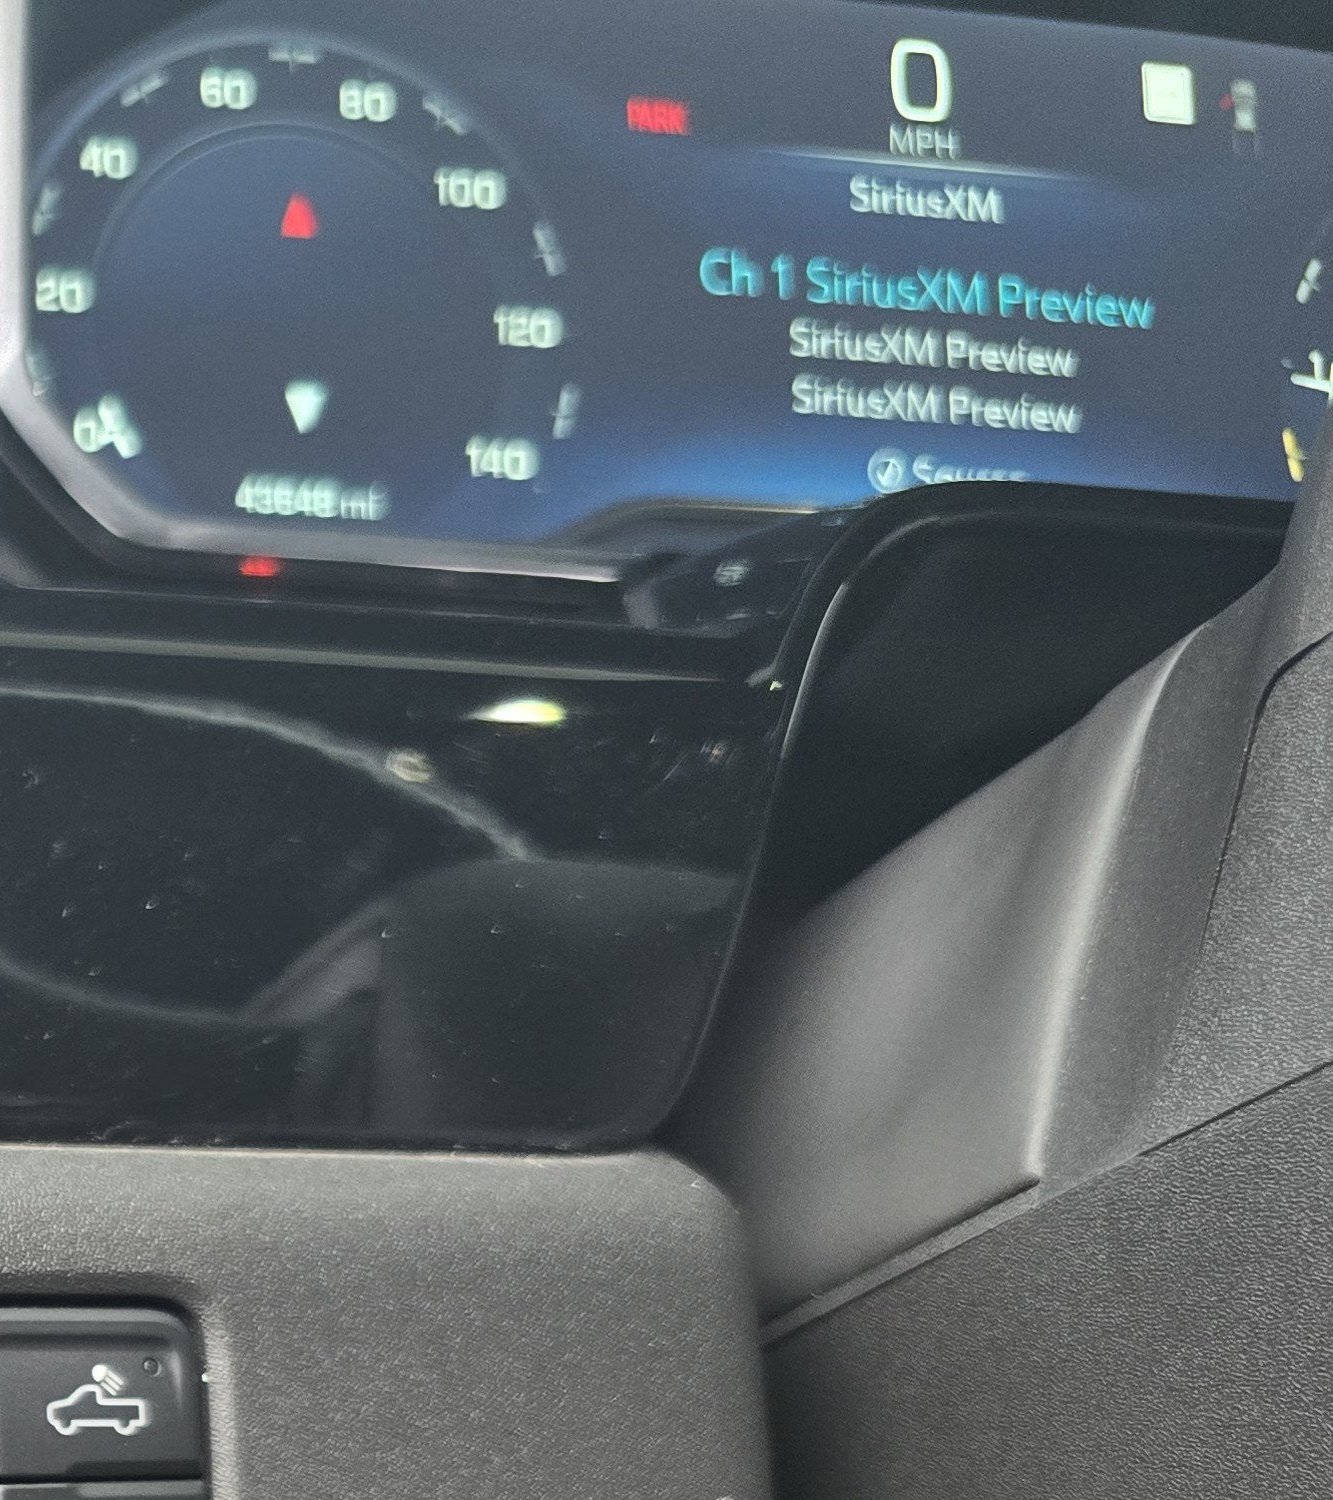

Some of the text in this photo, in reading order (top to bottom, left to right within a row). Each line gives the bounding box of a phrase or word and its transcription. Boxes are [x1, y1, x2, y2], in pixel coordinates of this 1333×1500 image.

[200, 67, 256, 109] 60
[339, 79, 396, 121] 80
[890, 38, 951, 122] 0
[79, 136, 137, 179] 40
[889, 122, 960, 158] MPH
[435, 167, 506, 209] 100
[849, 174, 1004, 223] SiriusXM
[36, 267, 94, 313] 20
[700, 246, 1155, 329] Ch 1 SiriusXM Preview
[493, 305, 565, 348] 120
[789, 317, 1080, 377] SiriusXM Preview
[791, 373, 1083, 433] SiriusXM Preview
[466, 435, 540, 481] 140
